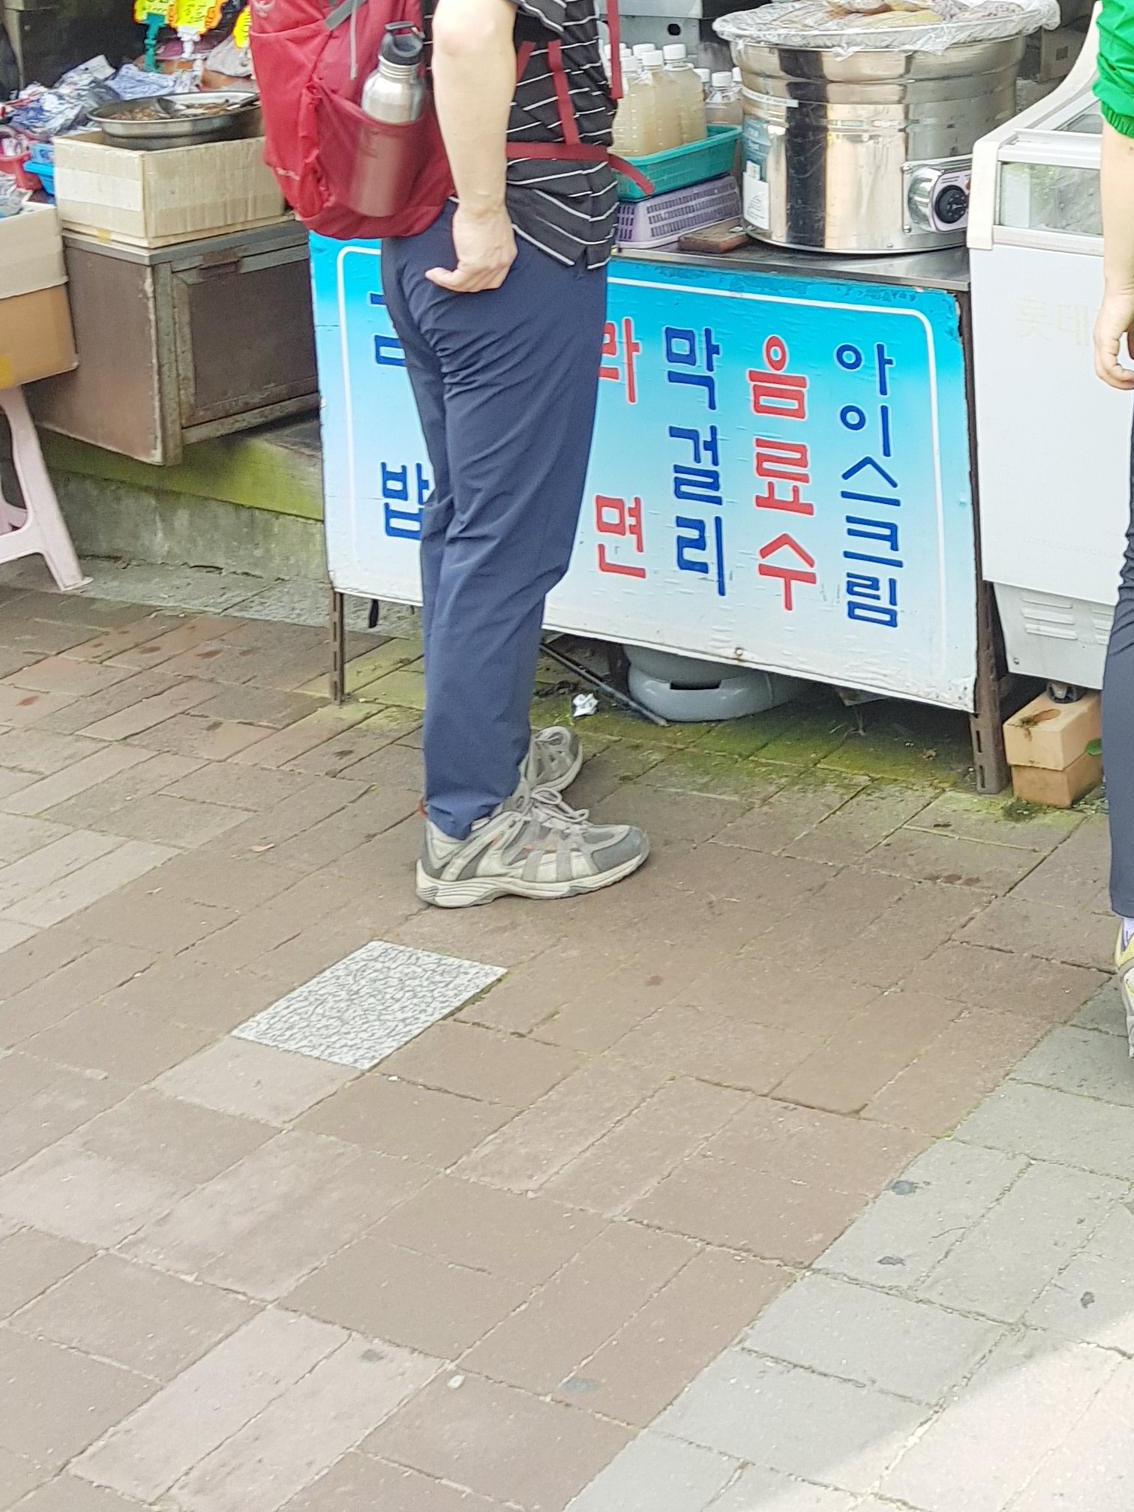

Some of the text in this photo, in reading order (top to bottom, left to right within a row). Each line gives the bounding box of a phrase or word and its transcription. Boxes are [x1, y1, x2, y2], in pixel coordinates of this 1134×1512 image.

[664, 325, 726, 597] 막걸리
[746, 333, 818, 612] 음료수
[836, 341, 905, 629] 아이스크림
